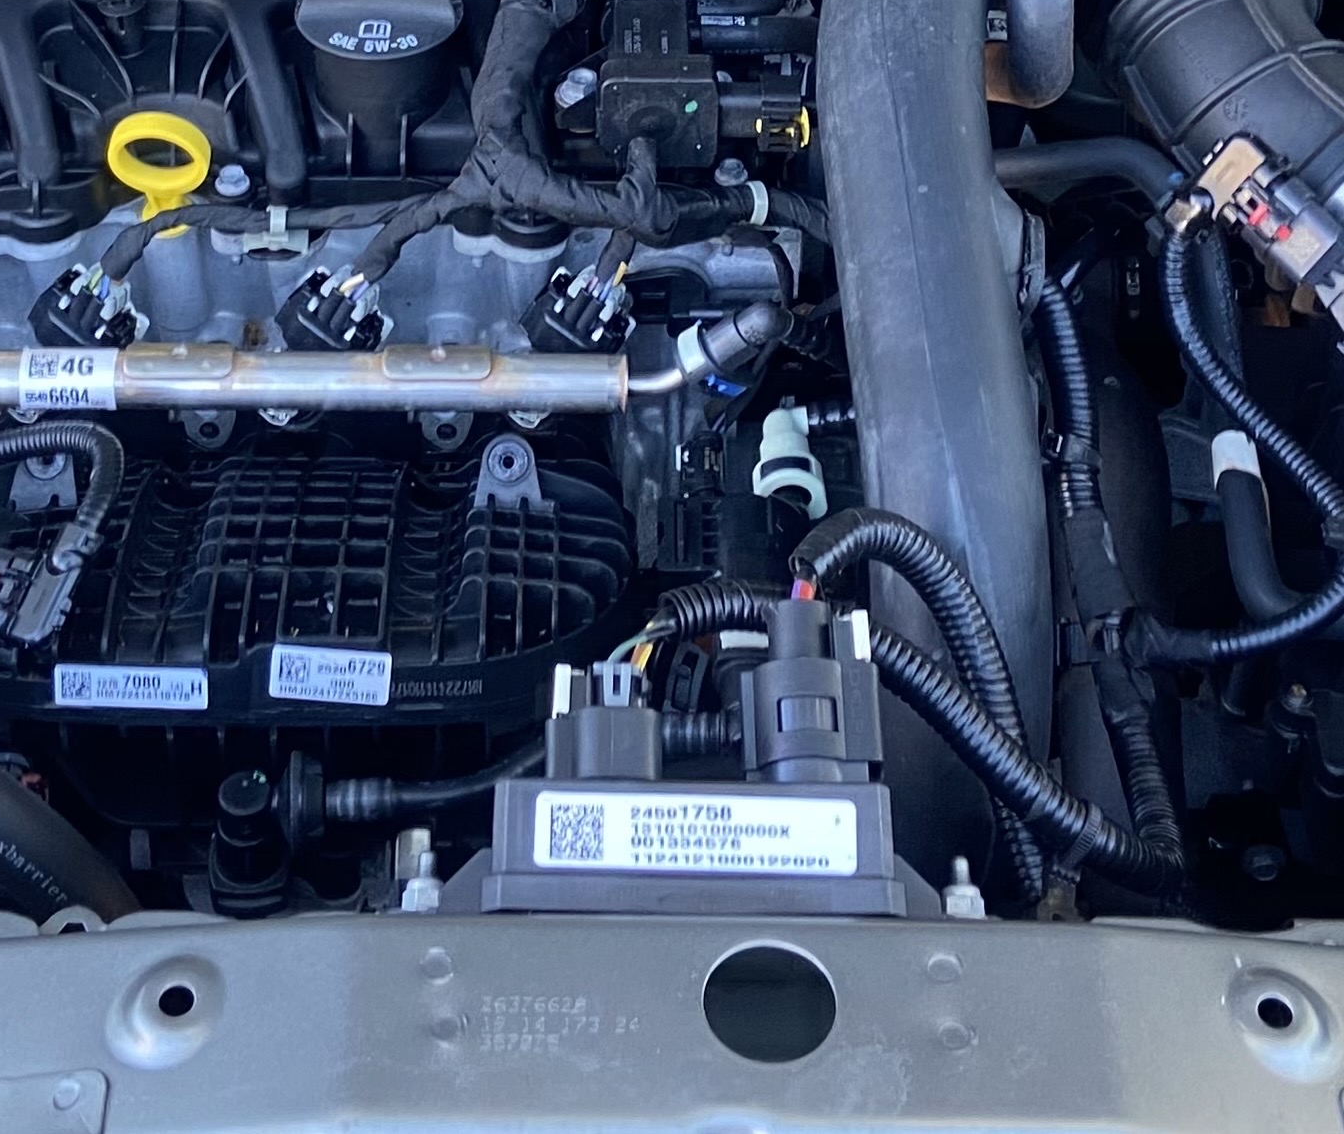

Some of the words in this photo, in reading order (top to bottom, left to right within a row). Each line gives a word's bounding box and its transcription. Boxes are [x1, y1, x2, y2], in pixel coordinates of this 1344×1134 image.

[329, 32, 358, 50] SAE
[363, 34, 418, 53] 5W-30
[61, 356, 94, 376] 4G
